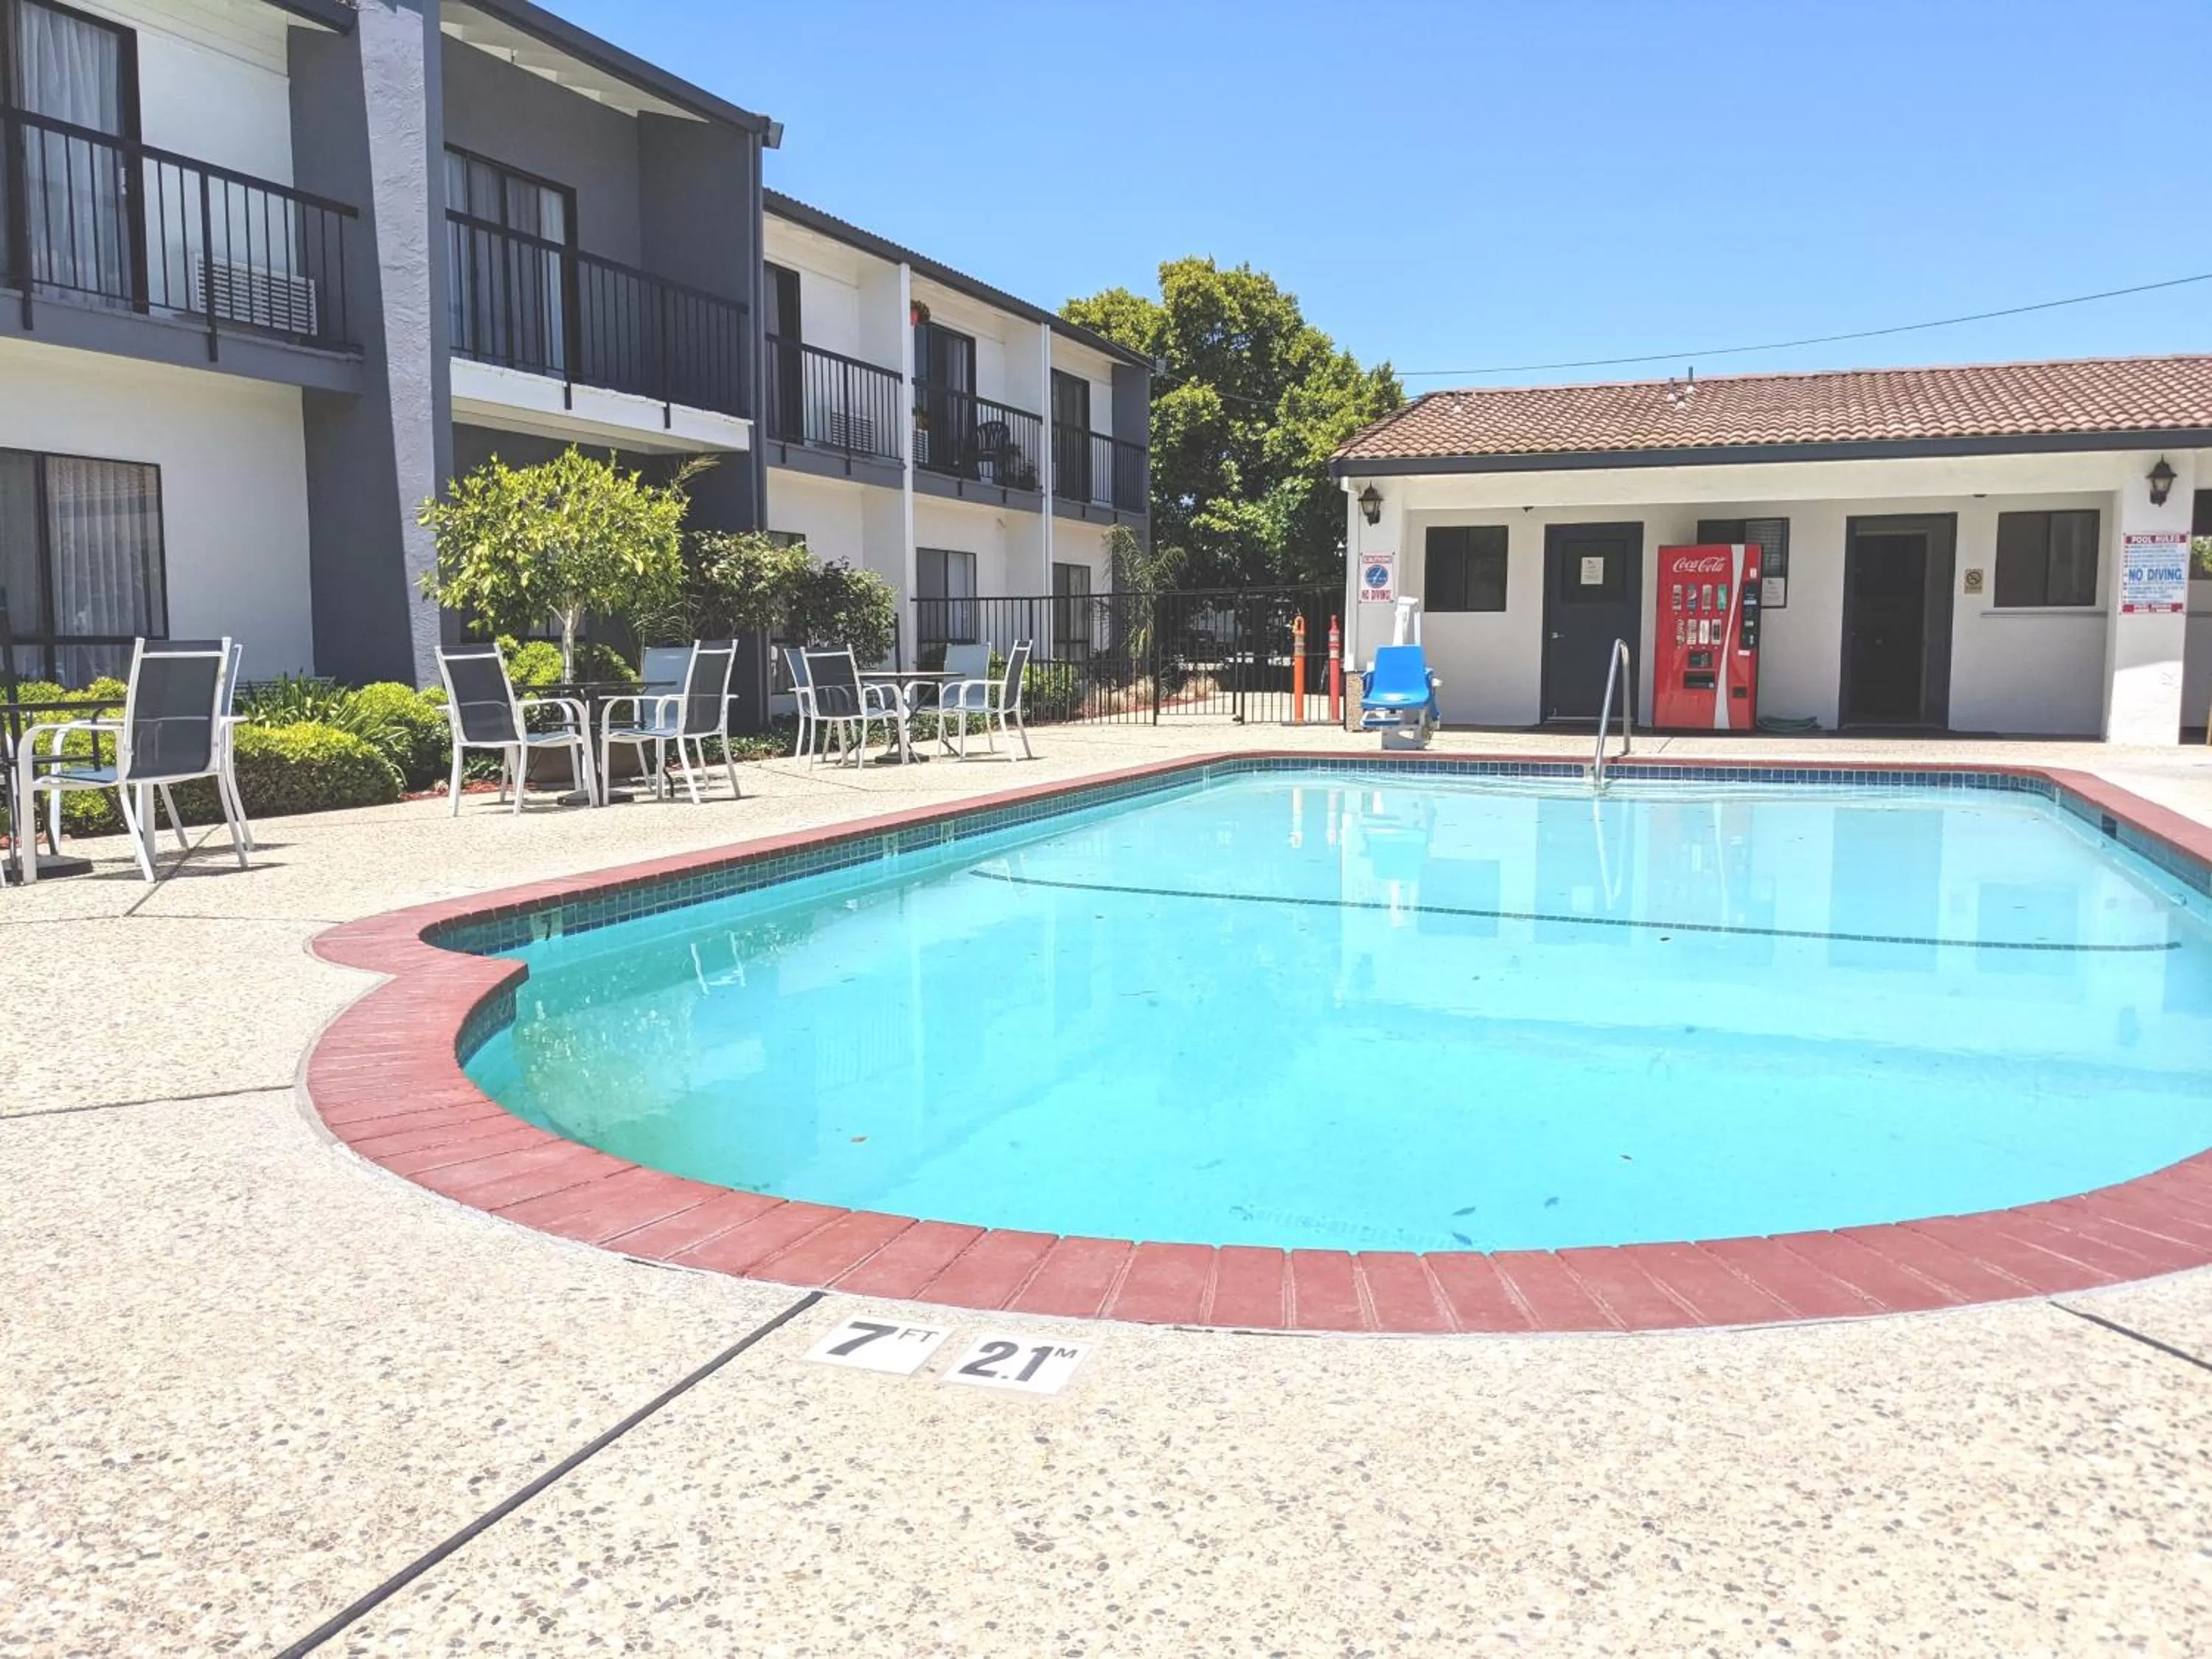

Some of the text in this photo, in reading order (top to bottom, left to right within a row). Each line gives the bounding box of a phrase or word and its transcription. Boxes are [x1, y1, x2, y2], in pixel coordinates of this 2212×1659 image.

[2129, 568, 2183, 581] NO DIVING
[826, 1321, 940, 1356] 7 FT
[958, 1340, 1079, 1382] 2.1 M
